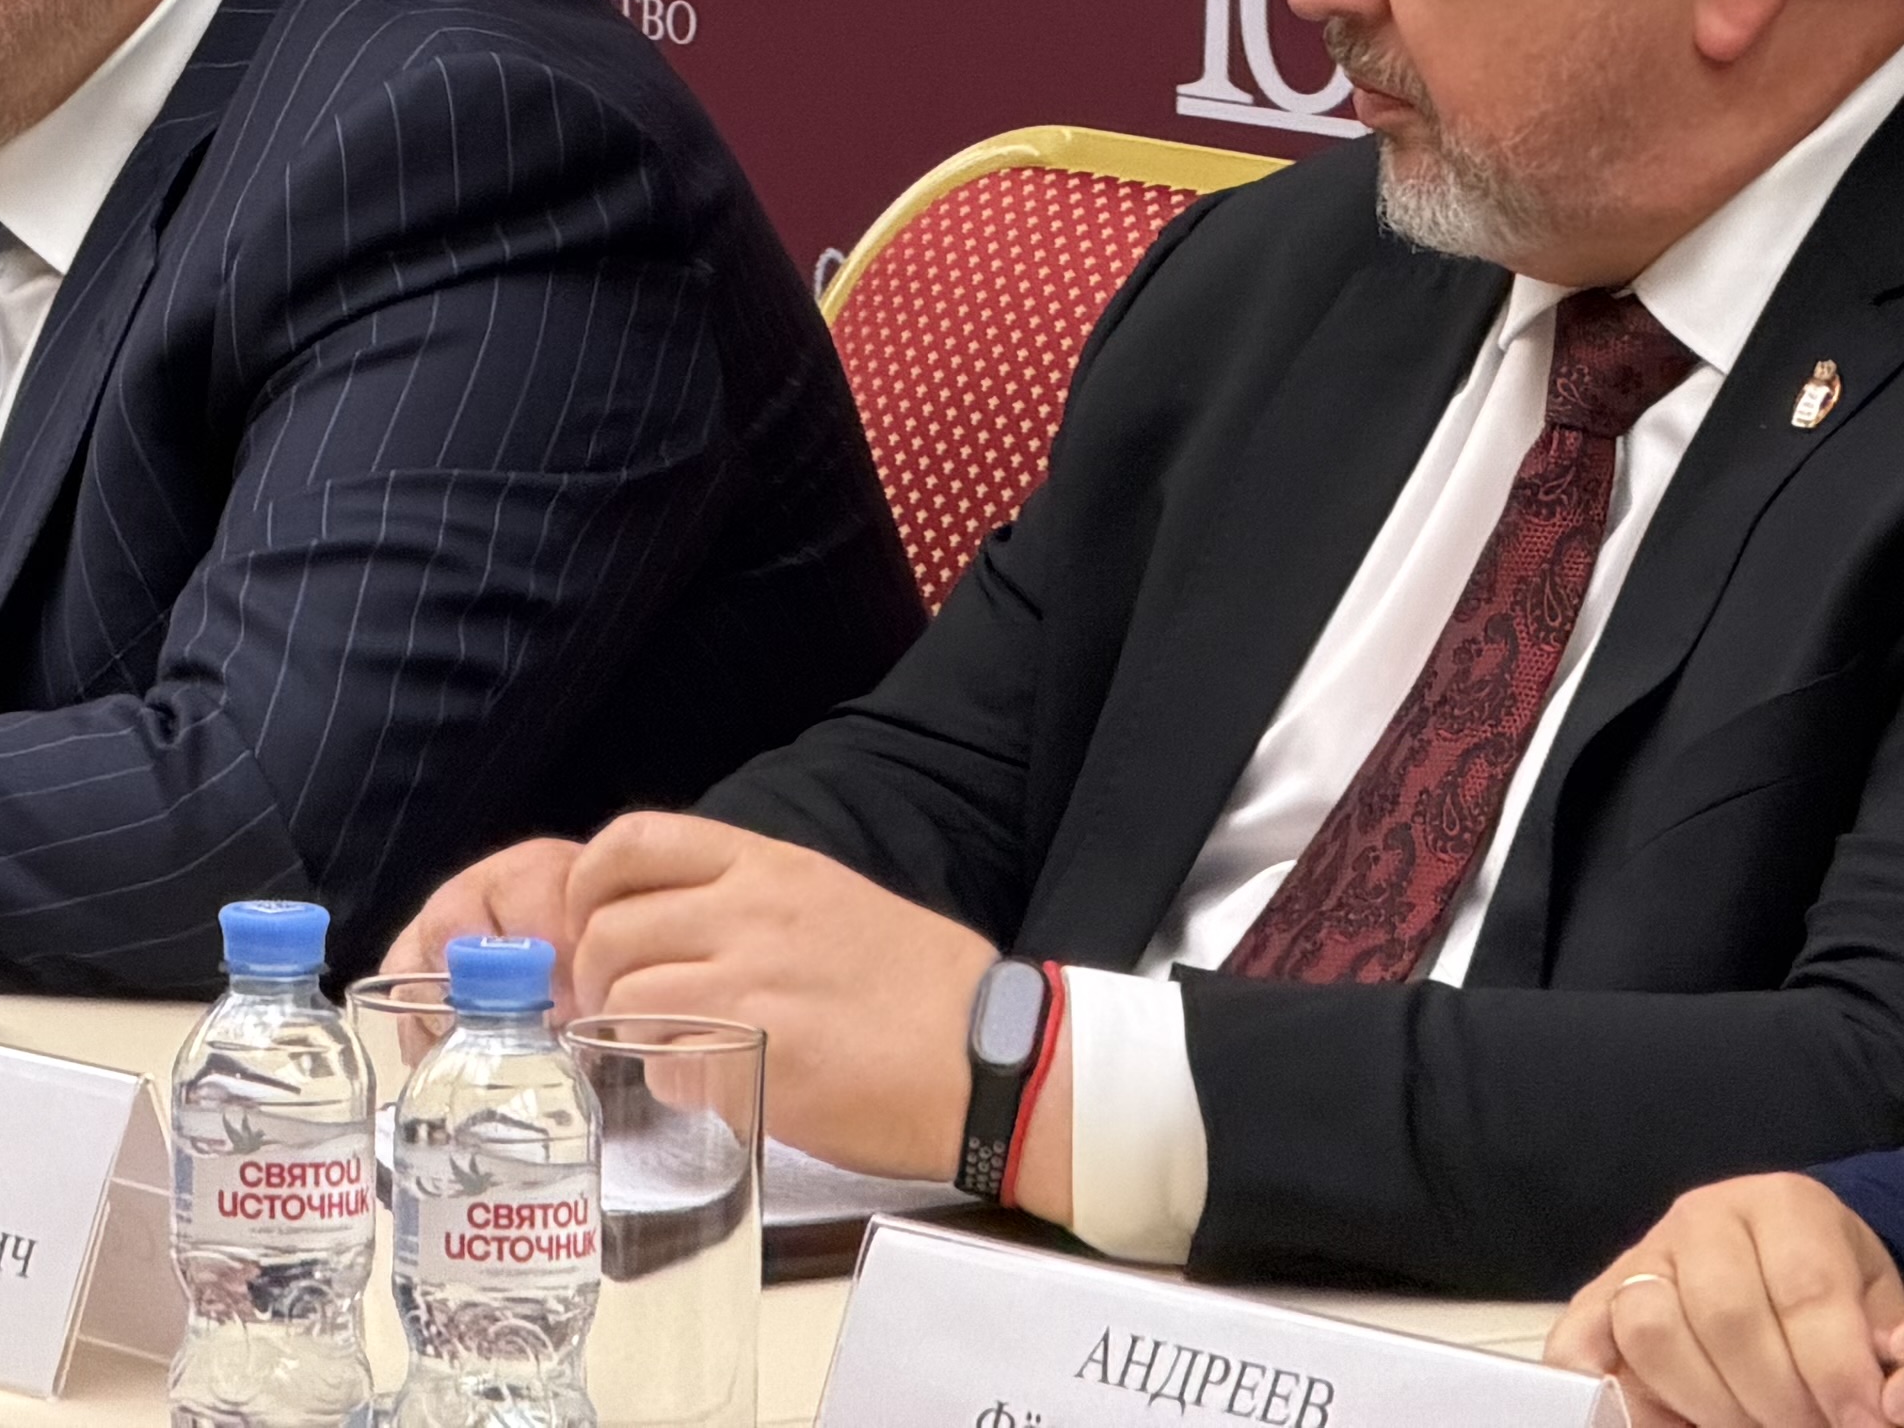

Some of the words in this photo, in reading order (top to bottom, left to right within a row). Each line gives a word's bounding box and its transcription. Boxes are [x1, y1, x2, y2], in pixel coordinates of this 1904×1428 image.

[238, 1151, 362, 1190] СВЯТОЙ
[217, 1185, 370, 1222] ИСТОЧНИК
[466, 1192, 589, 1230] СВЯТОЙ
[444, 1228, 597, 1265] ИСТОЧНИК
[1074, 1325, 1336, 1428] АНДРЕЕВ
